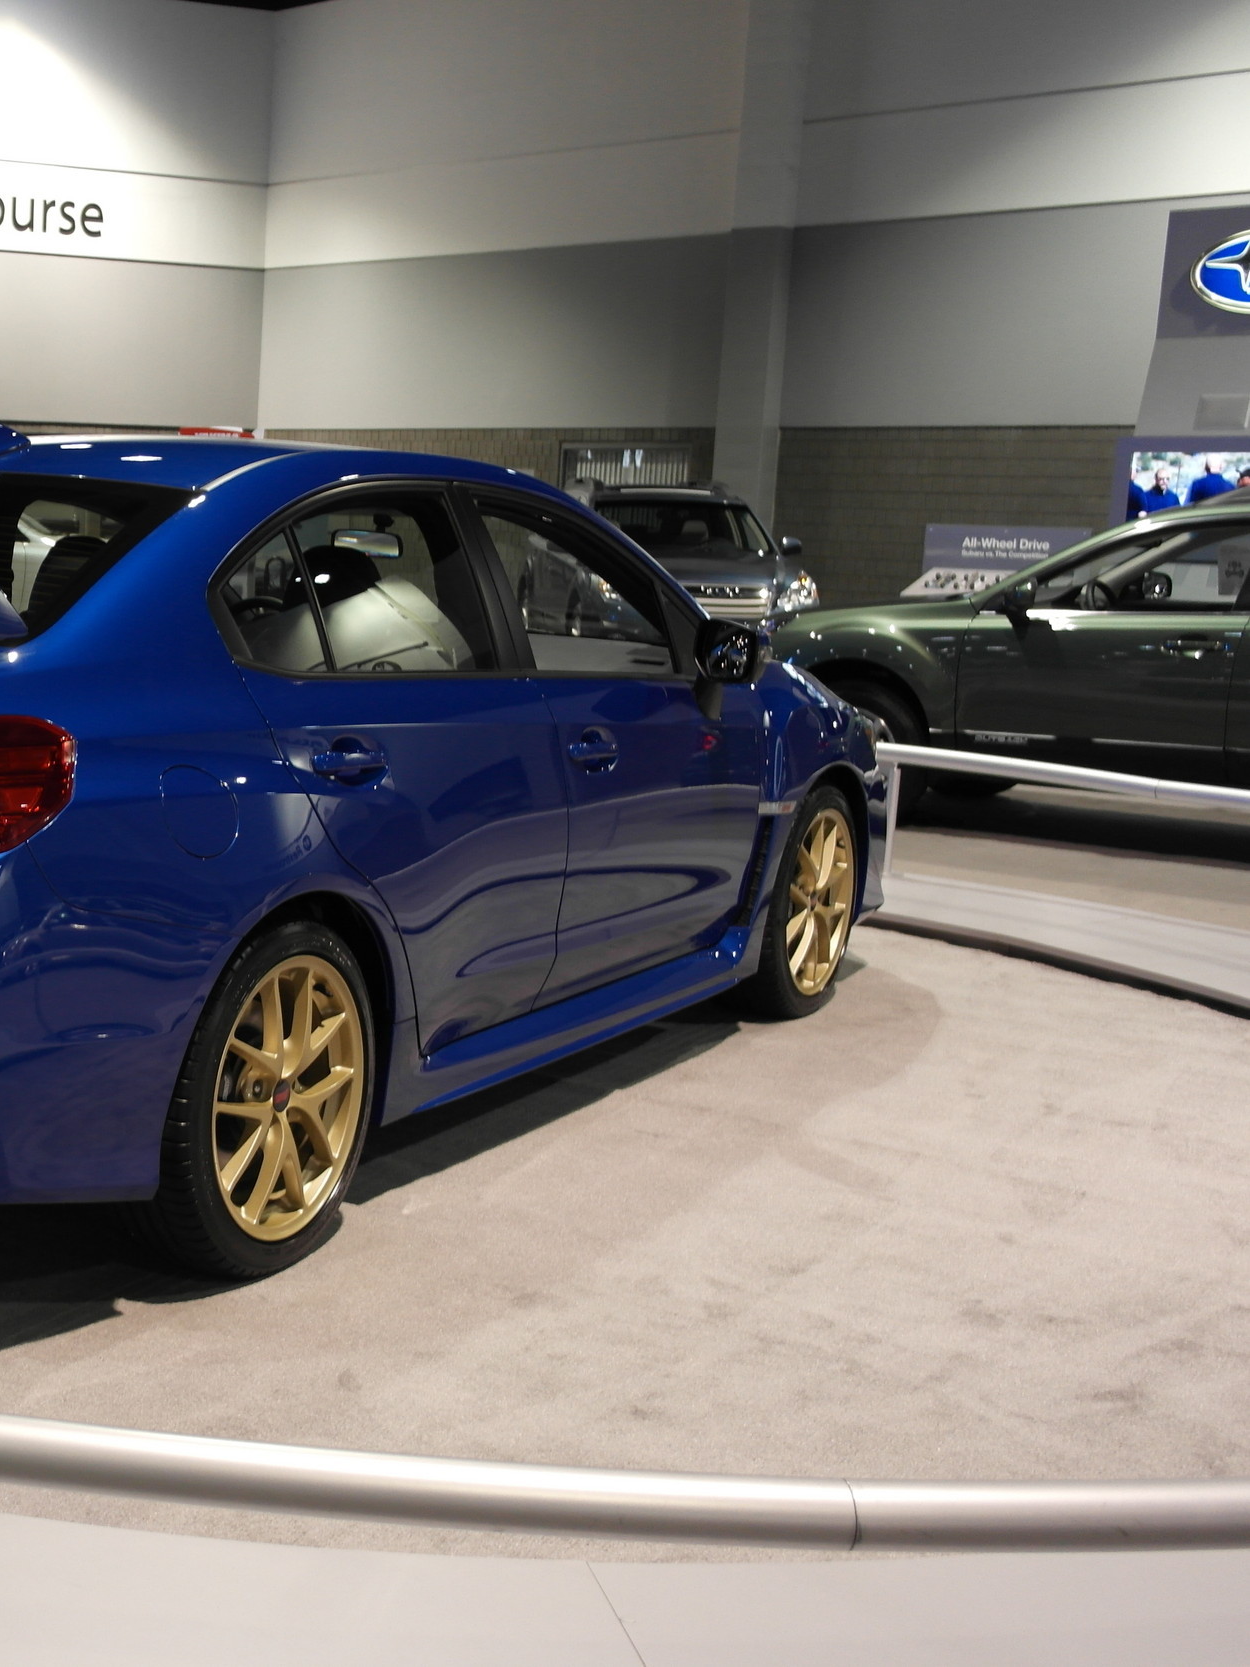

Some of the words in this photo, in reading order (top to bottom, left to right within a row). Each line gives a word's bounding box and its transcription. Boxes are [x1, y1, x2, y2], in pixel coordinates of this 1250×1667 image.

[962, 536, 1017, 549] All-Wheel
[1019, 538, 1050, 551] Drive
[995, 550, 1007, 558] The
